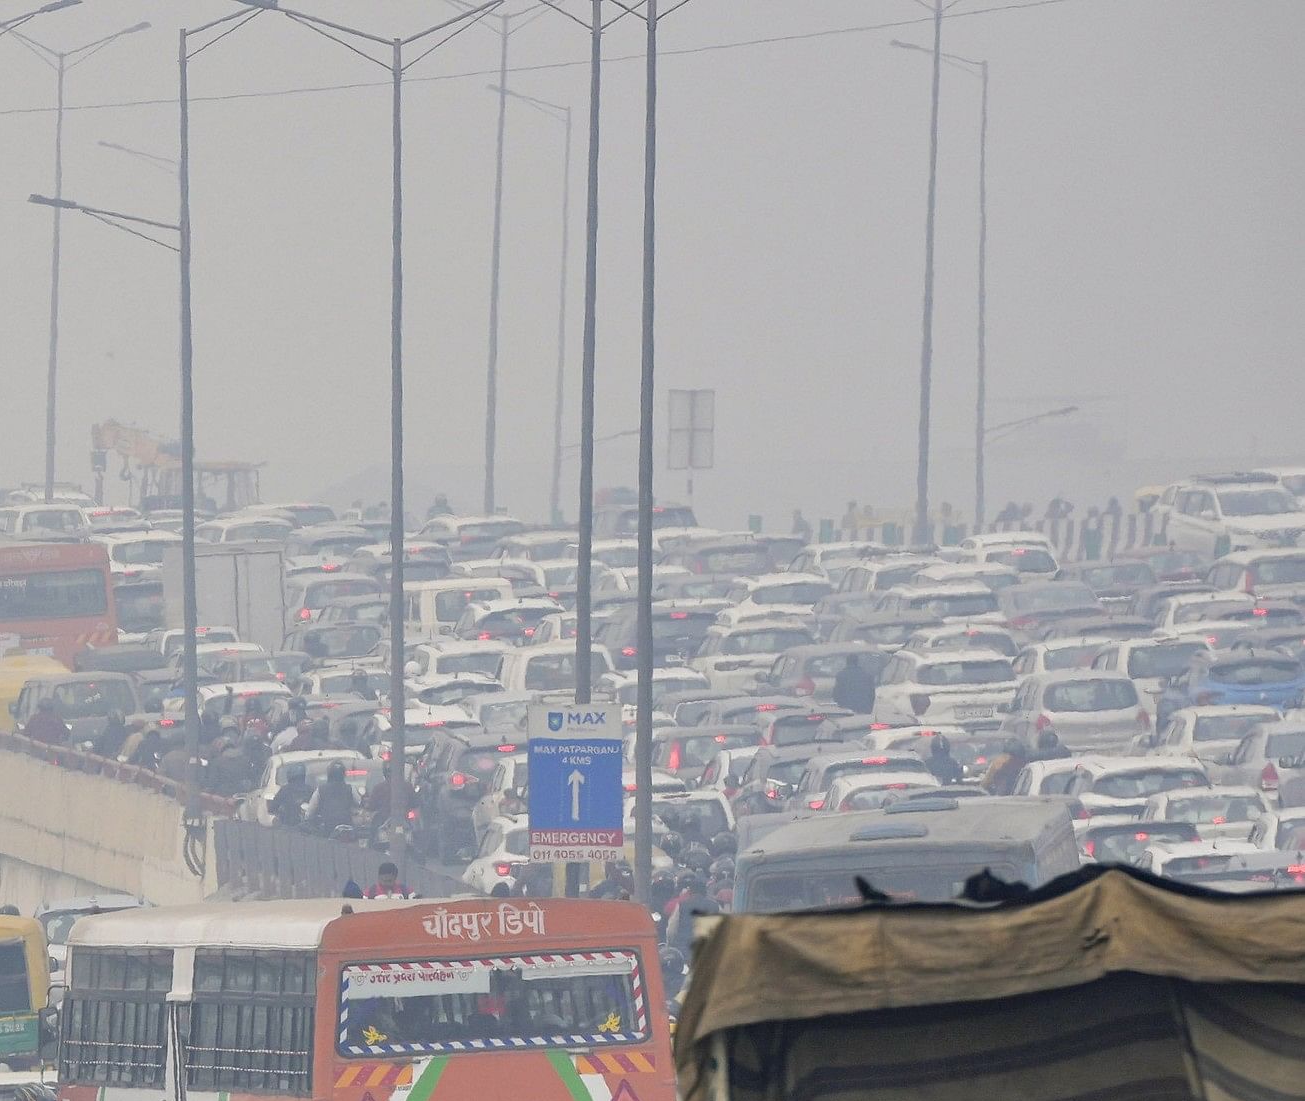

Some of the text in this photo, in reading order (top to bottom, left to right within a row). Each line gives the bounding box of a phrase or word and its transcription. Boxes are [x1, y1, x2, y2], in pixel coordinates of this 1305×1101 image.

[567, 711, 607, 725] MAX
[558, 746, 621, 755] PATPARGANJ
[569, 757, 592, 765] KMS
[532, 832, 616, 845] EMERGENCY
[497, 901, 547, 936] डिपो
